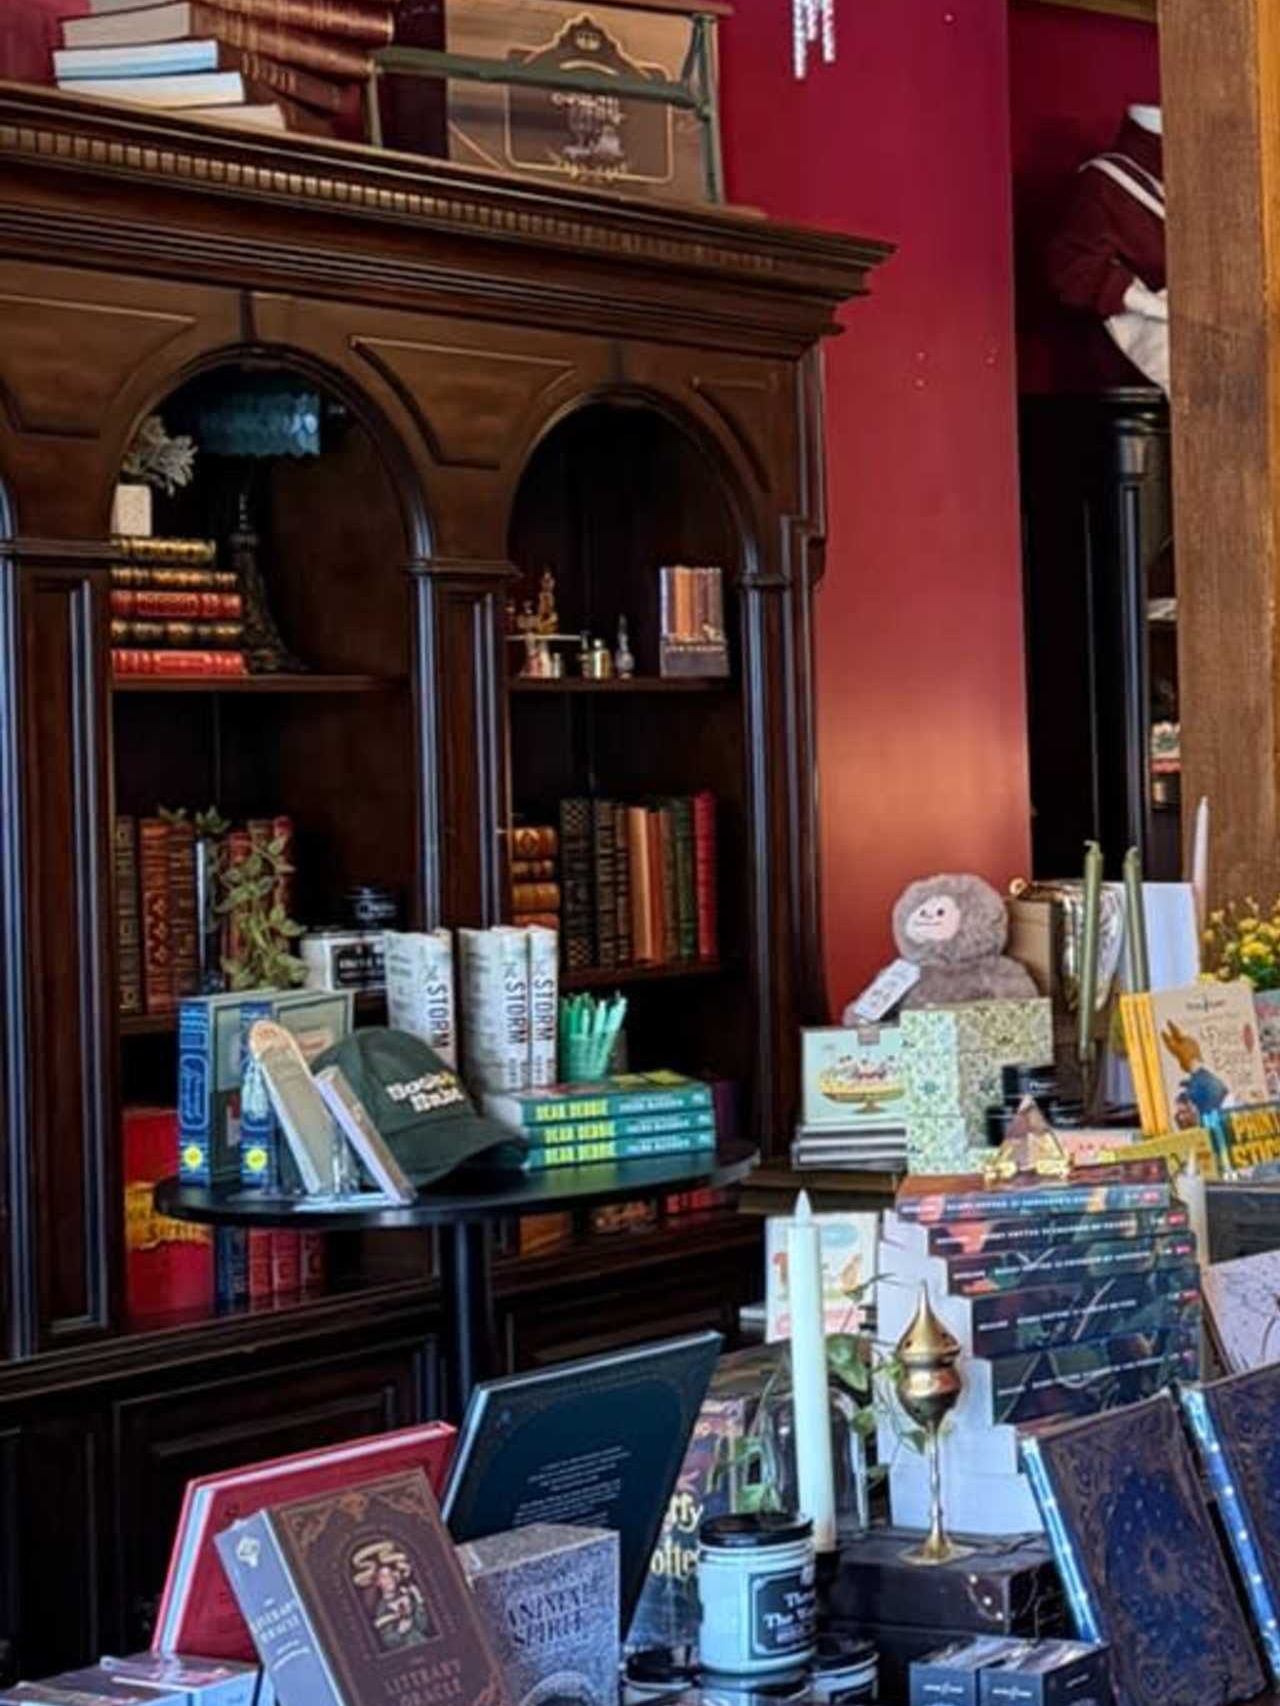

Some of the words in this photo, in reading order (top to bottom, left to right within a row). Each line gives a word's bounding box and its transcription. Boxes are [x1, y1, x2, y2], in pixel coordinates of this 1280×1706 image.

[427, 983, 451, 1050] STORM
[504, 979, 528, 1046] STORM
[532, 977, 556, 1044] STORM
[535, 1103, 569, 1122] DEAR
[543, 1125, 577, 1146] DEAR
[543, 1147, 576, 1167] DEAR
